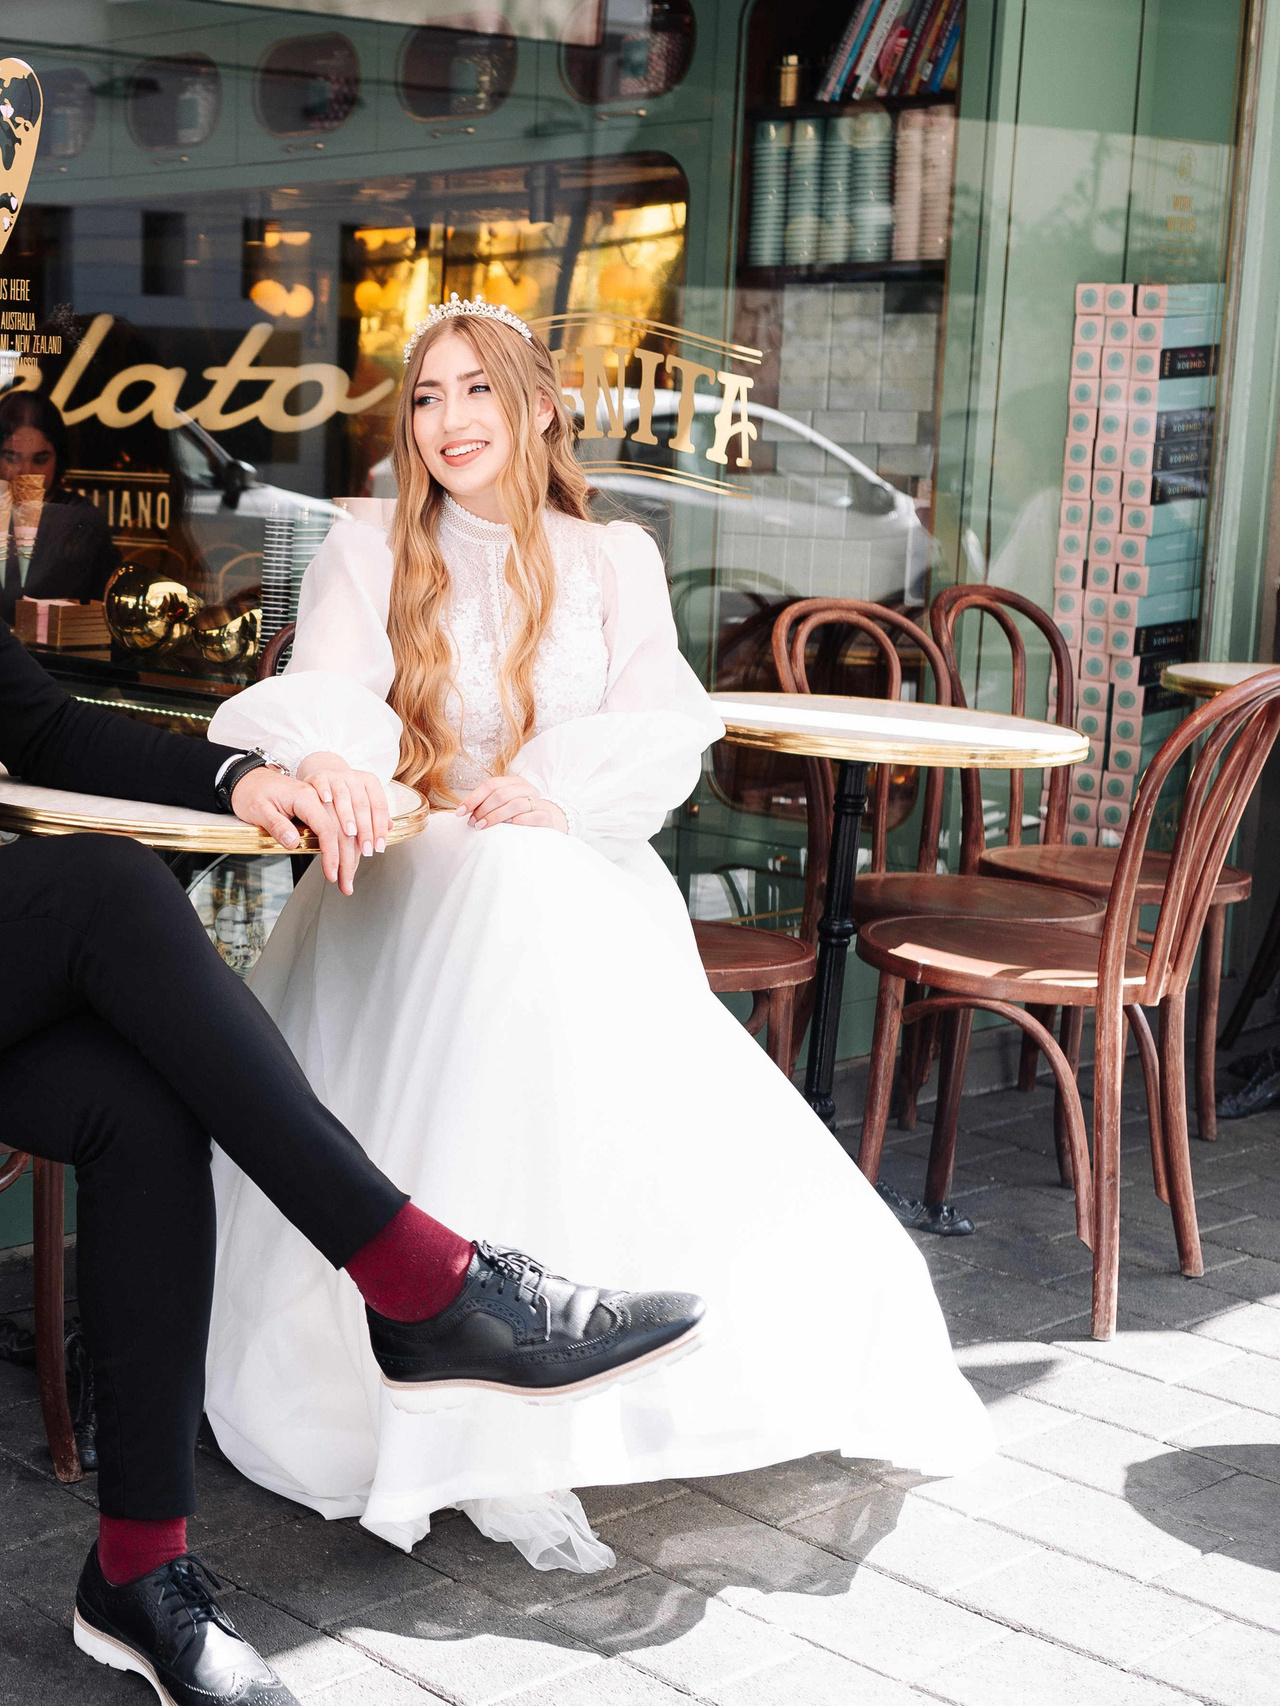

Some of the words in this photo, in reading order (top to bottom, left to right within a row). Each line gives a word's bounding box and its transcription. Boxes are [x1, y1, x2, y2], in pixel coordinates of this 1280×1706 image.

[10, 278, 31, 302] HERE
[0, 311, 36, 331] AUSTRALIA
[15, 334, 31, 353] NEW
[32, 334, 62, 355] ZEALAND
